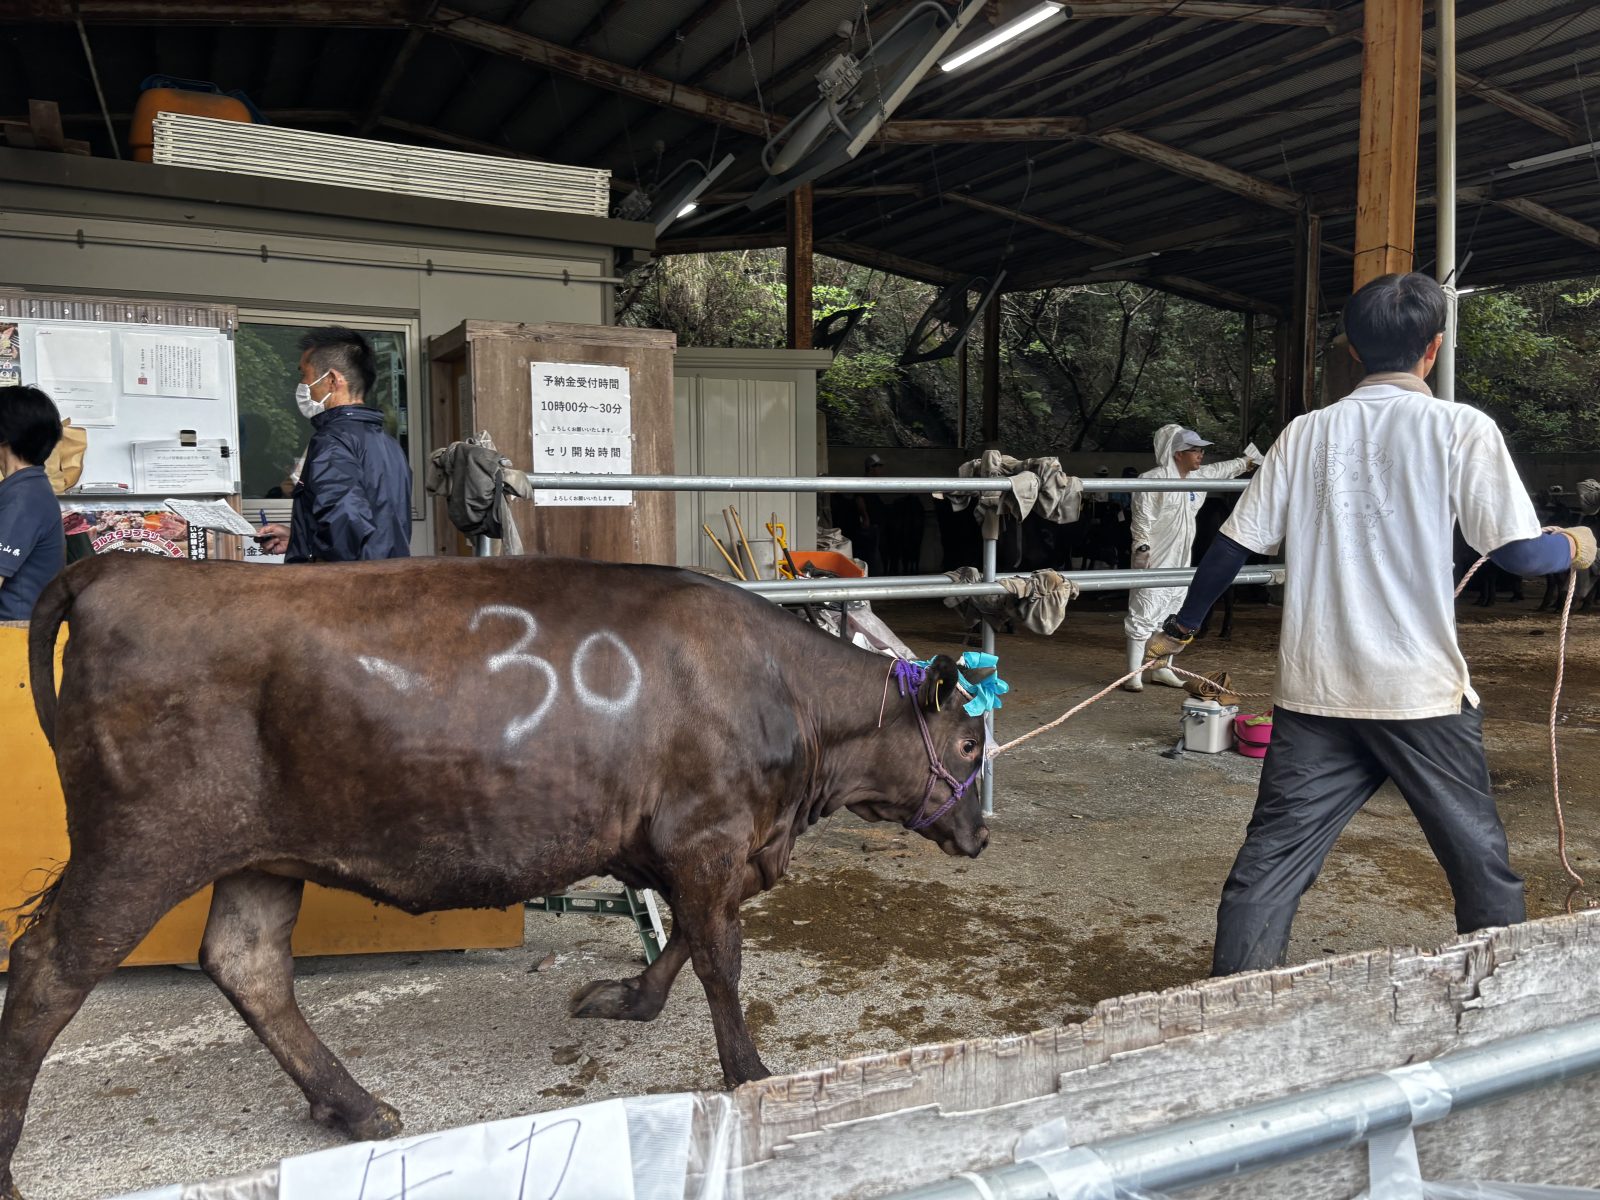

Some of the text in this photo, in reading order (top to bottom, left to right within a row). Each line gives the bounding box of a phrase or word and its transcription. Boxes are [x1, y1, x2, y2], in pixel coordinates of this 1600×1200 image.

[543, 375, 620, 390] 予納金受付時間
[551, 425, 614, 433] よろしくお願いいたします。
[545, 446, 621, 458] セリ開始時間
[469, 604, 643, 743] 30
